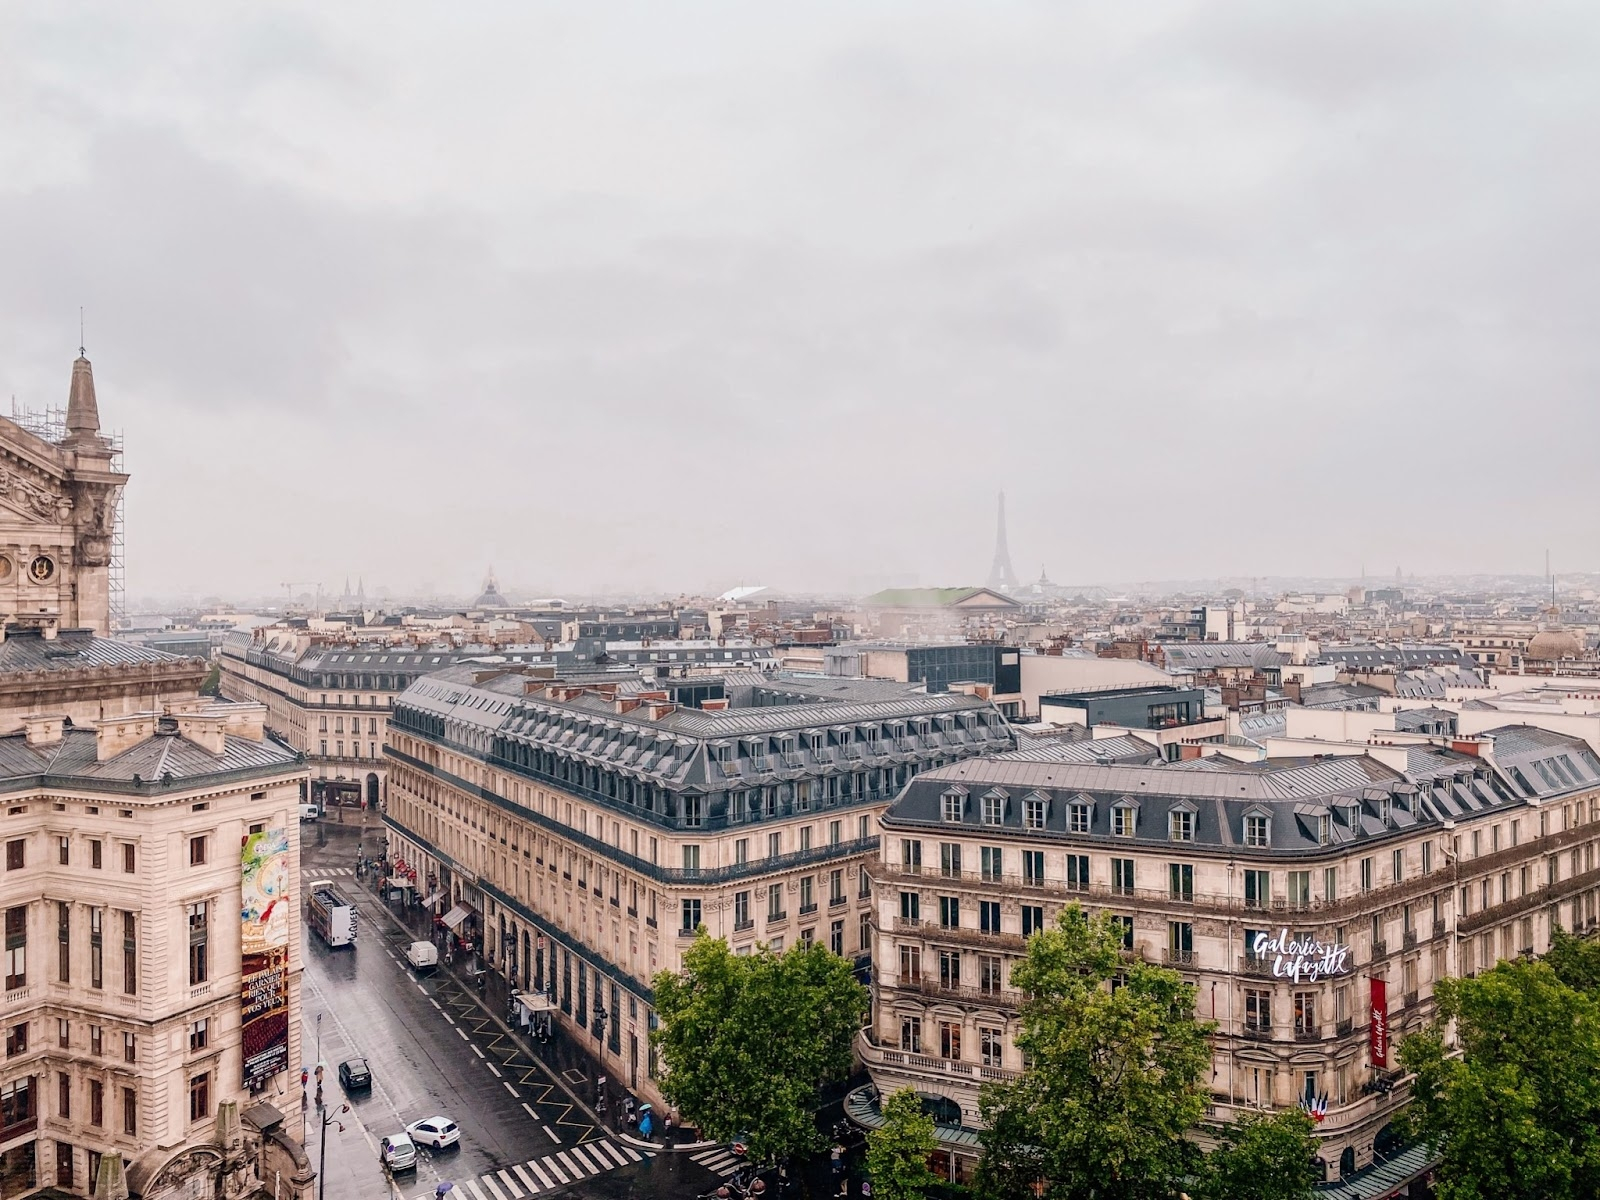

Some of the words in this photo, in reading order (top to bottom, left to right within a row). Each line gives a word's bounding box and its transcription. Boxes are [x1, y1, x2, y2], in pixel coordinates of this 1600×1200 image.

[1253, 928, 1324, 960] Galeries
[1273, 944, 1350, 984] Lafayette
[248, 987, 265, 998] RIEN
[267, 981, 282, 992] QUE
[249, 973, 281, 990] GARNIER
[248, 1002, 261, 1013] VOS
[263, 995, 283, 1008] YEUX
[255, 990, 276, 1003] POUR
